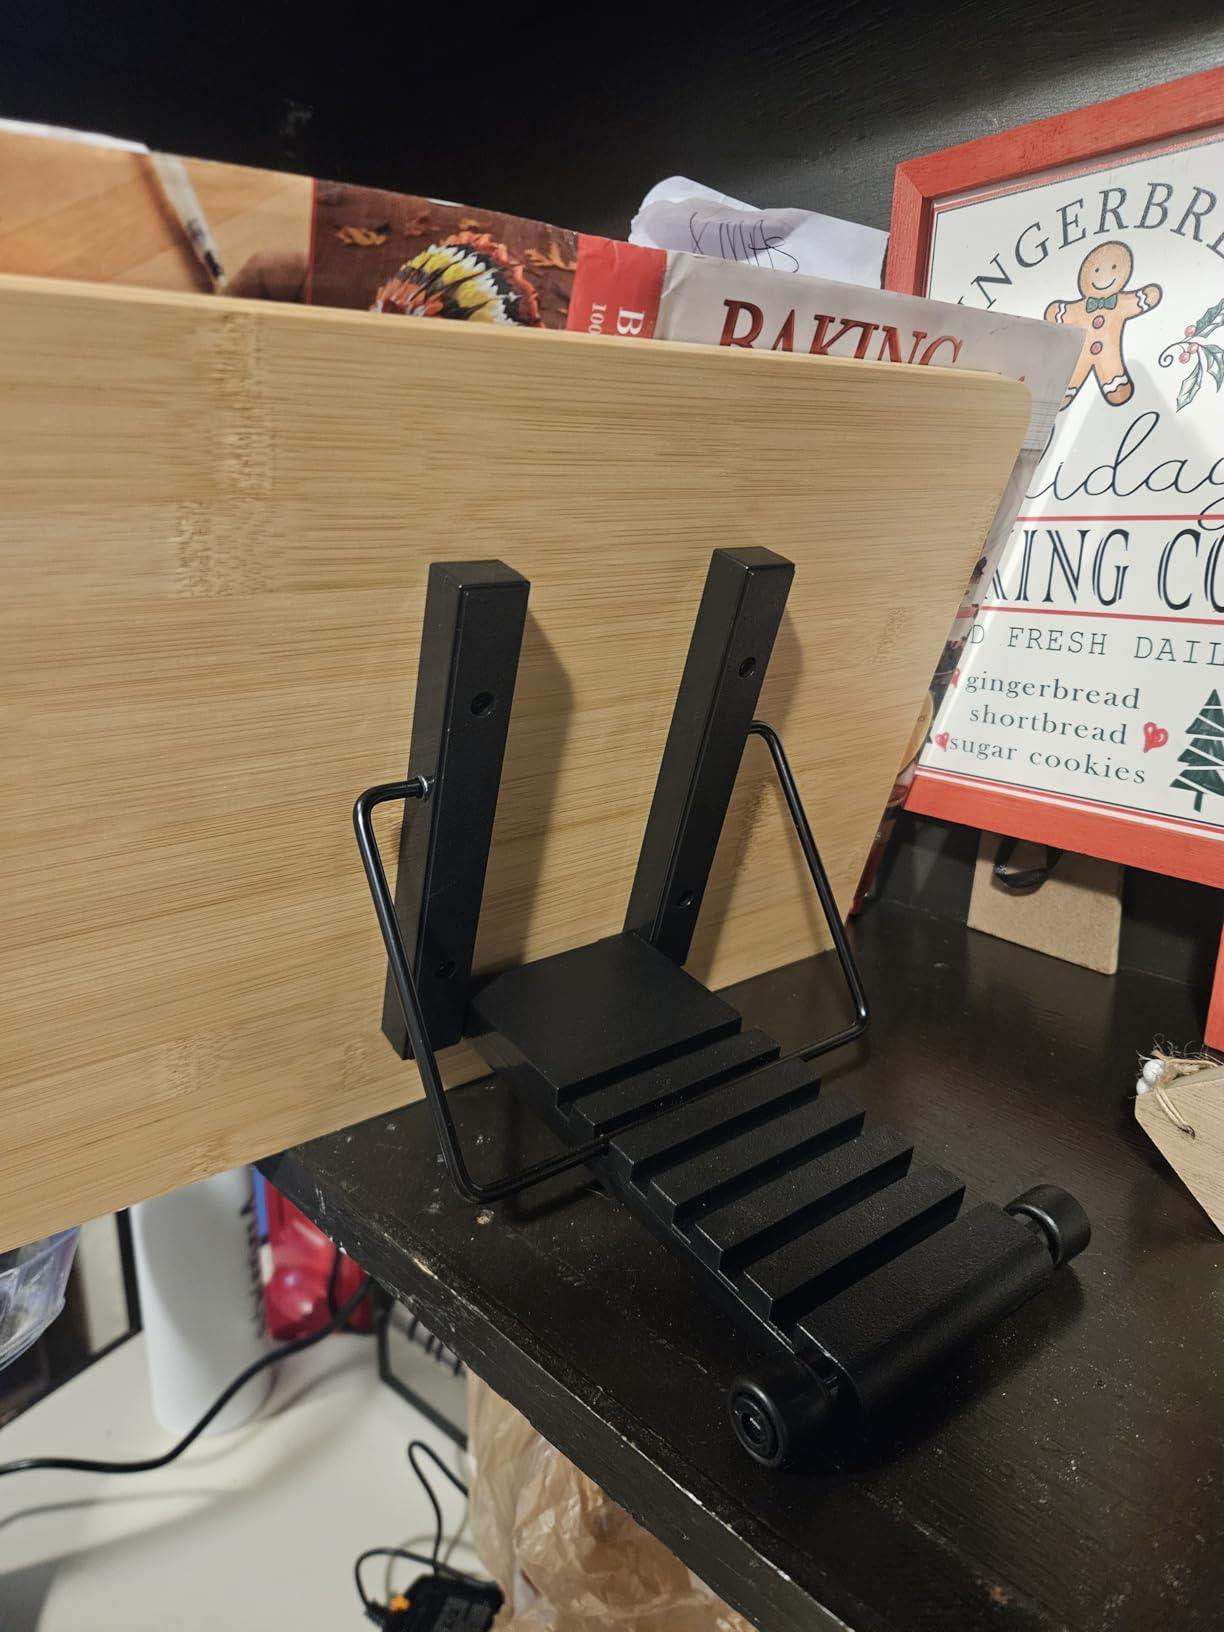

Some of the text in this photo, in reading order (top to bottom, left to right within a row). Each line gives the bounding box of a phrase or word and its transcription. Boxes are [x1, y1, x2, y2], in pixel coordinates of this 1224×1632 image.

[956, 182, 1224, 310] NGERBR
[1007, 626, 1108, 656] FRESH
[965, 670, 1141, 710] gingerbread
[969, 704, 1128, 745] shortbread
[949, 736, 1146, 785] sugar cookies
